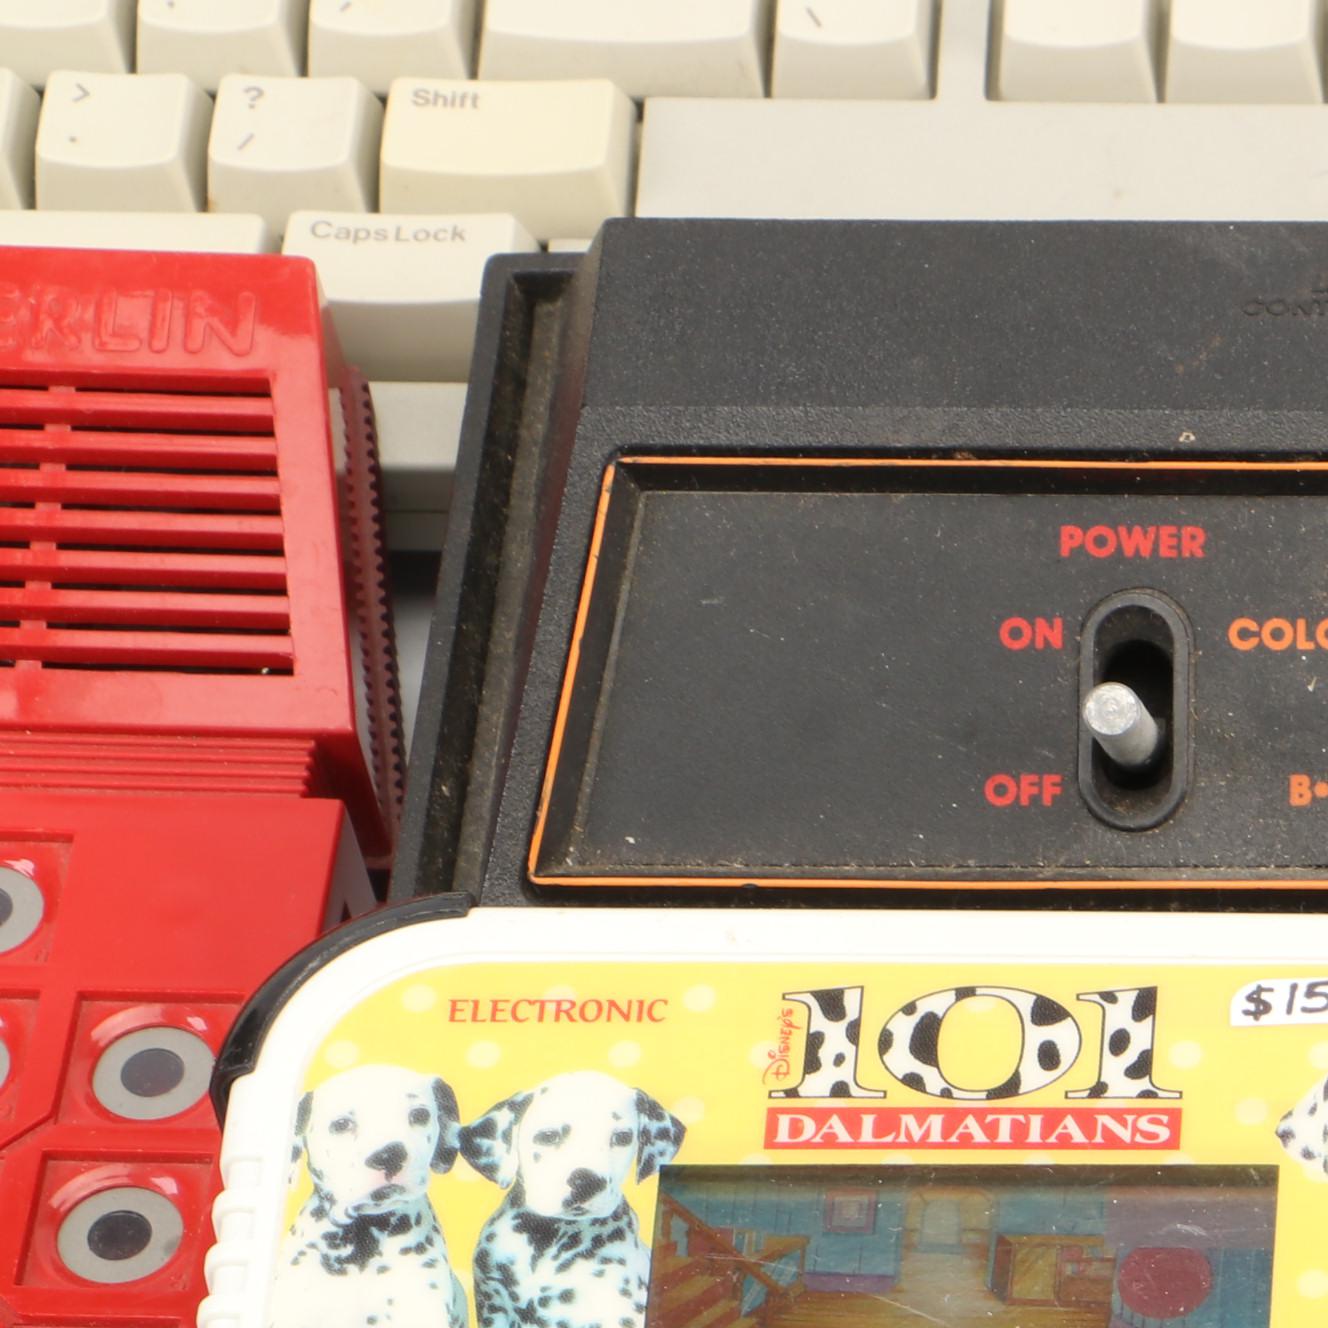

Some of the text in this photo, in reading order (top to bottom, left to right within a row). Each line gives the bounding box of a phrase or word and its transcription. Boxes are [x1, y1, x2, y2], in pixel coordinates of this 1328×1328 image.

[410, 87, 481, 110] Shift
[1059, 524, 1208, 560] POWER
[998, 616, 1064, 651] ON
[983, 773, 1063, 808] OFF
[447, 998, 669, 1025] ELECTRONIC
[767, 985, 1183, 1101] 101
[772, 1112, 1172, 1146] DALMATIANS
